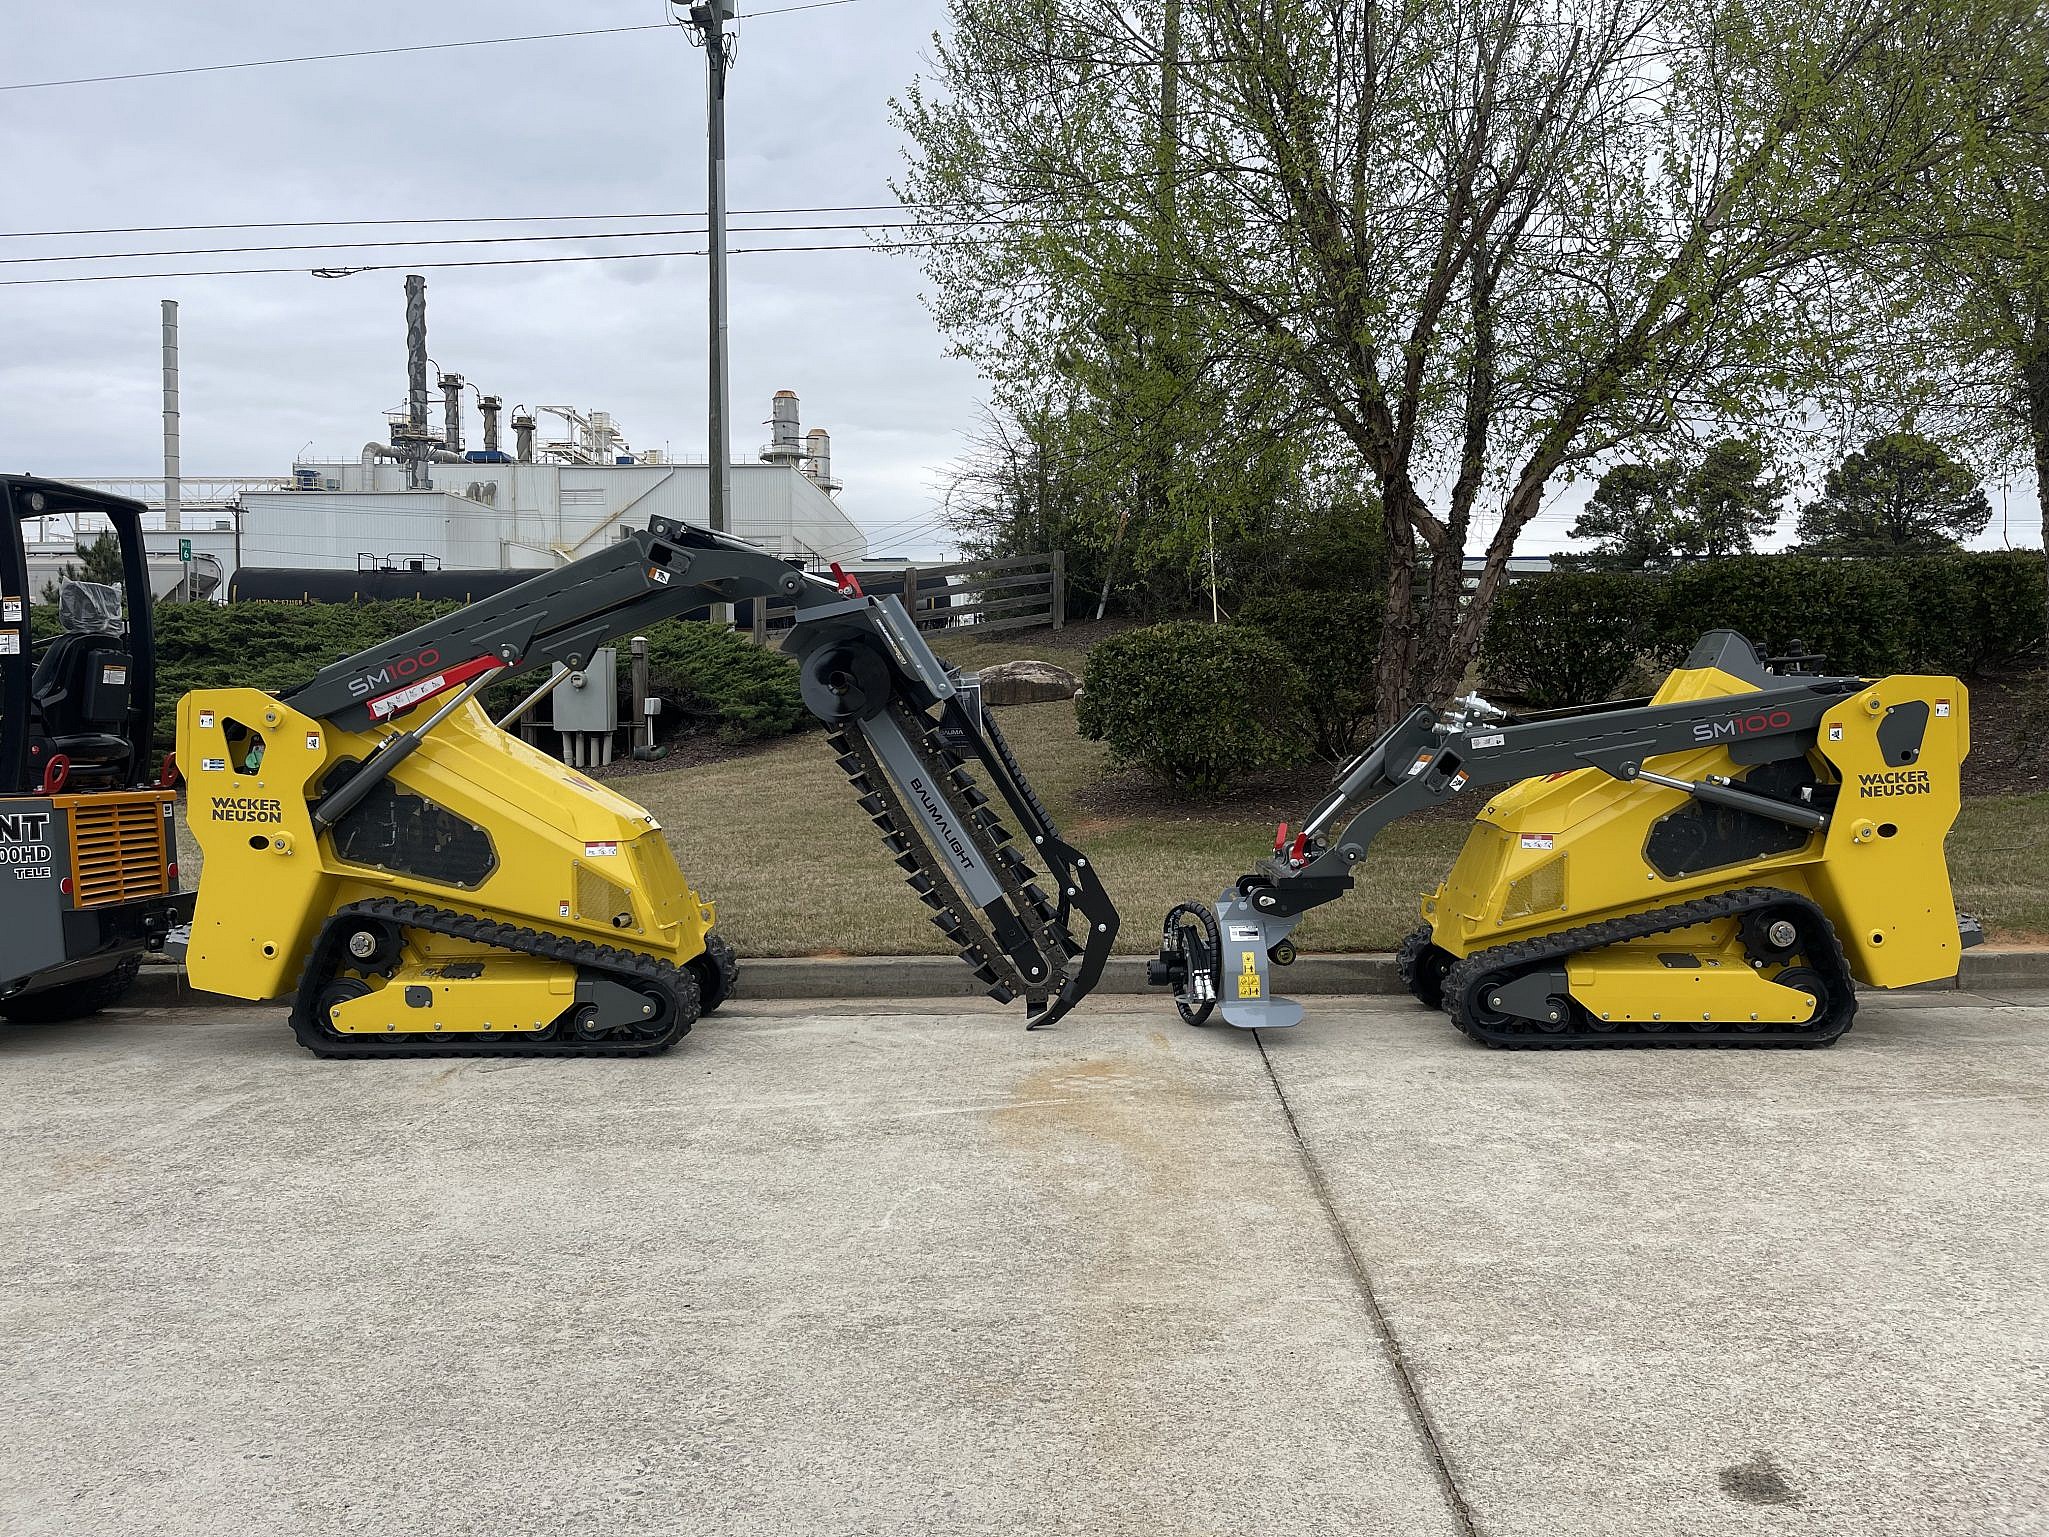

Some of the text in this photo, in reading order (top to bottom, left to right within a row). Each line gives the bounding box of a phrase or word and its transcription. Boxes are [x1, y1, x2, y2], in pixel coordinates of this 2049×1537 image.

[184, 549, 190, 558] 6
[348, 649, 441, 697] SM100
[1693, 711, 1792, 742] SM100
[1858, 771, 1929, 786] WACKER
[1860, 782, 1930, 798] NEUSON
[211, 797, 281, 811] WACKER
[212, 809, 281, 823] NEUSON
[910, 778, 975, 869] BAUMALIGHT
[14, 867, 51, 880] TELE
